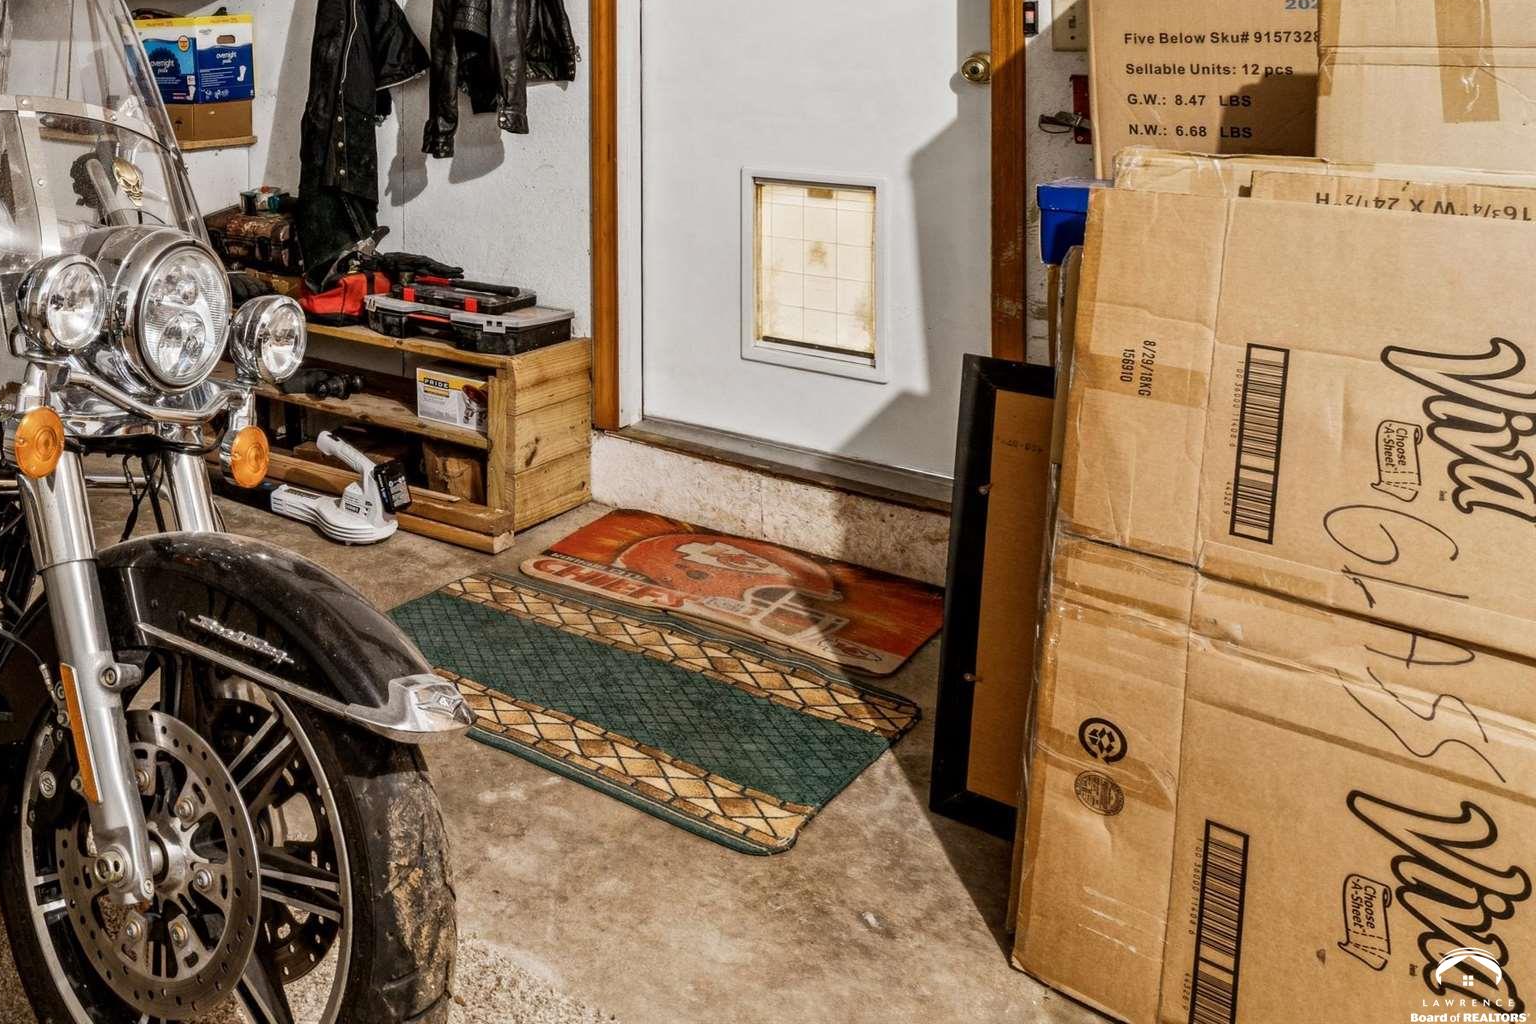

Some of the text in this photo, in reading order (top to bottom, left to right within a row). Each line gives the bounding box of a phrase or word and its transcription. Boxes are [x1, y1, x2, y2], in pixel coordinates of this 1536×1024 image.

[1123, 32, 1155, 44] Five
[1159, 32, 1206, 44] Below
[1210, 31, 1250, 44] Sku#
[1125, 63, 1294, 77] Sellable Units: 12 pcs
[1127, 93, 1252, 107] G.W.: 8.47 LBS
[1128, 124, 1253, 138] N.W.: 6.68 LBS
[1315, 192, 1330, 205] H
[1119, 348, 1136, 383] 156910
[423, 378, 449, 389] PRIDE
[1380, 337, 1536, 524] Viva
[1395, 427, 1408, 467] Choose
[532, 559, 686, 608] CHIEFS
[1346, 789, 1533, 1018] Viva
[1363, 885, 1377, 929] Choose
